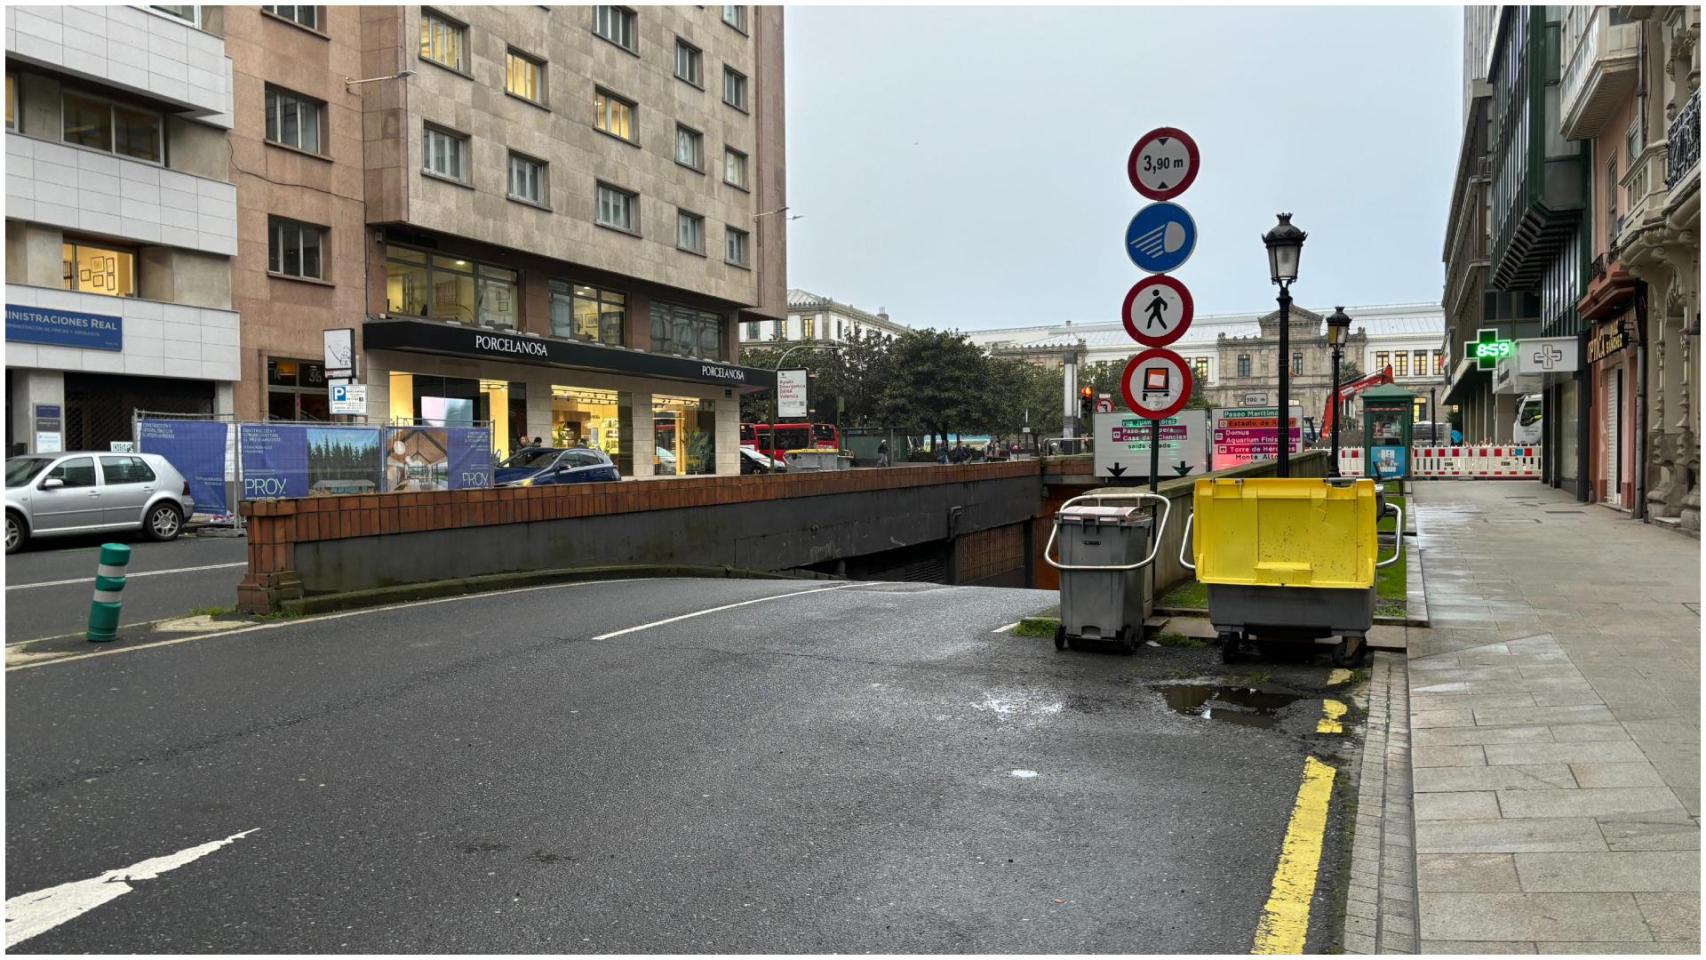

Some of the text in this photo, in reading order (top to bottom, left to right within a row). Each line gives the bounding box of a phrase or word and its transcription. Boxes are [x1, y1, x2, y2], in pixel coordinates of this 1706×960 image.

[1143, 154, 1184, 175] 3,90 m
[5, 311, 89, 328] INISTRACIONES
[91, 318, 118, 331] REAL
[475, 335, 548, 357] PORCELANOSA
[702, 365, 745, 380] PORCELANOSA
[334, 387, 345, 401] P
[1225, 437, 1259, 445] Aquarium
